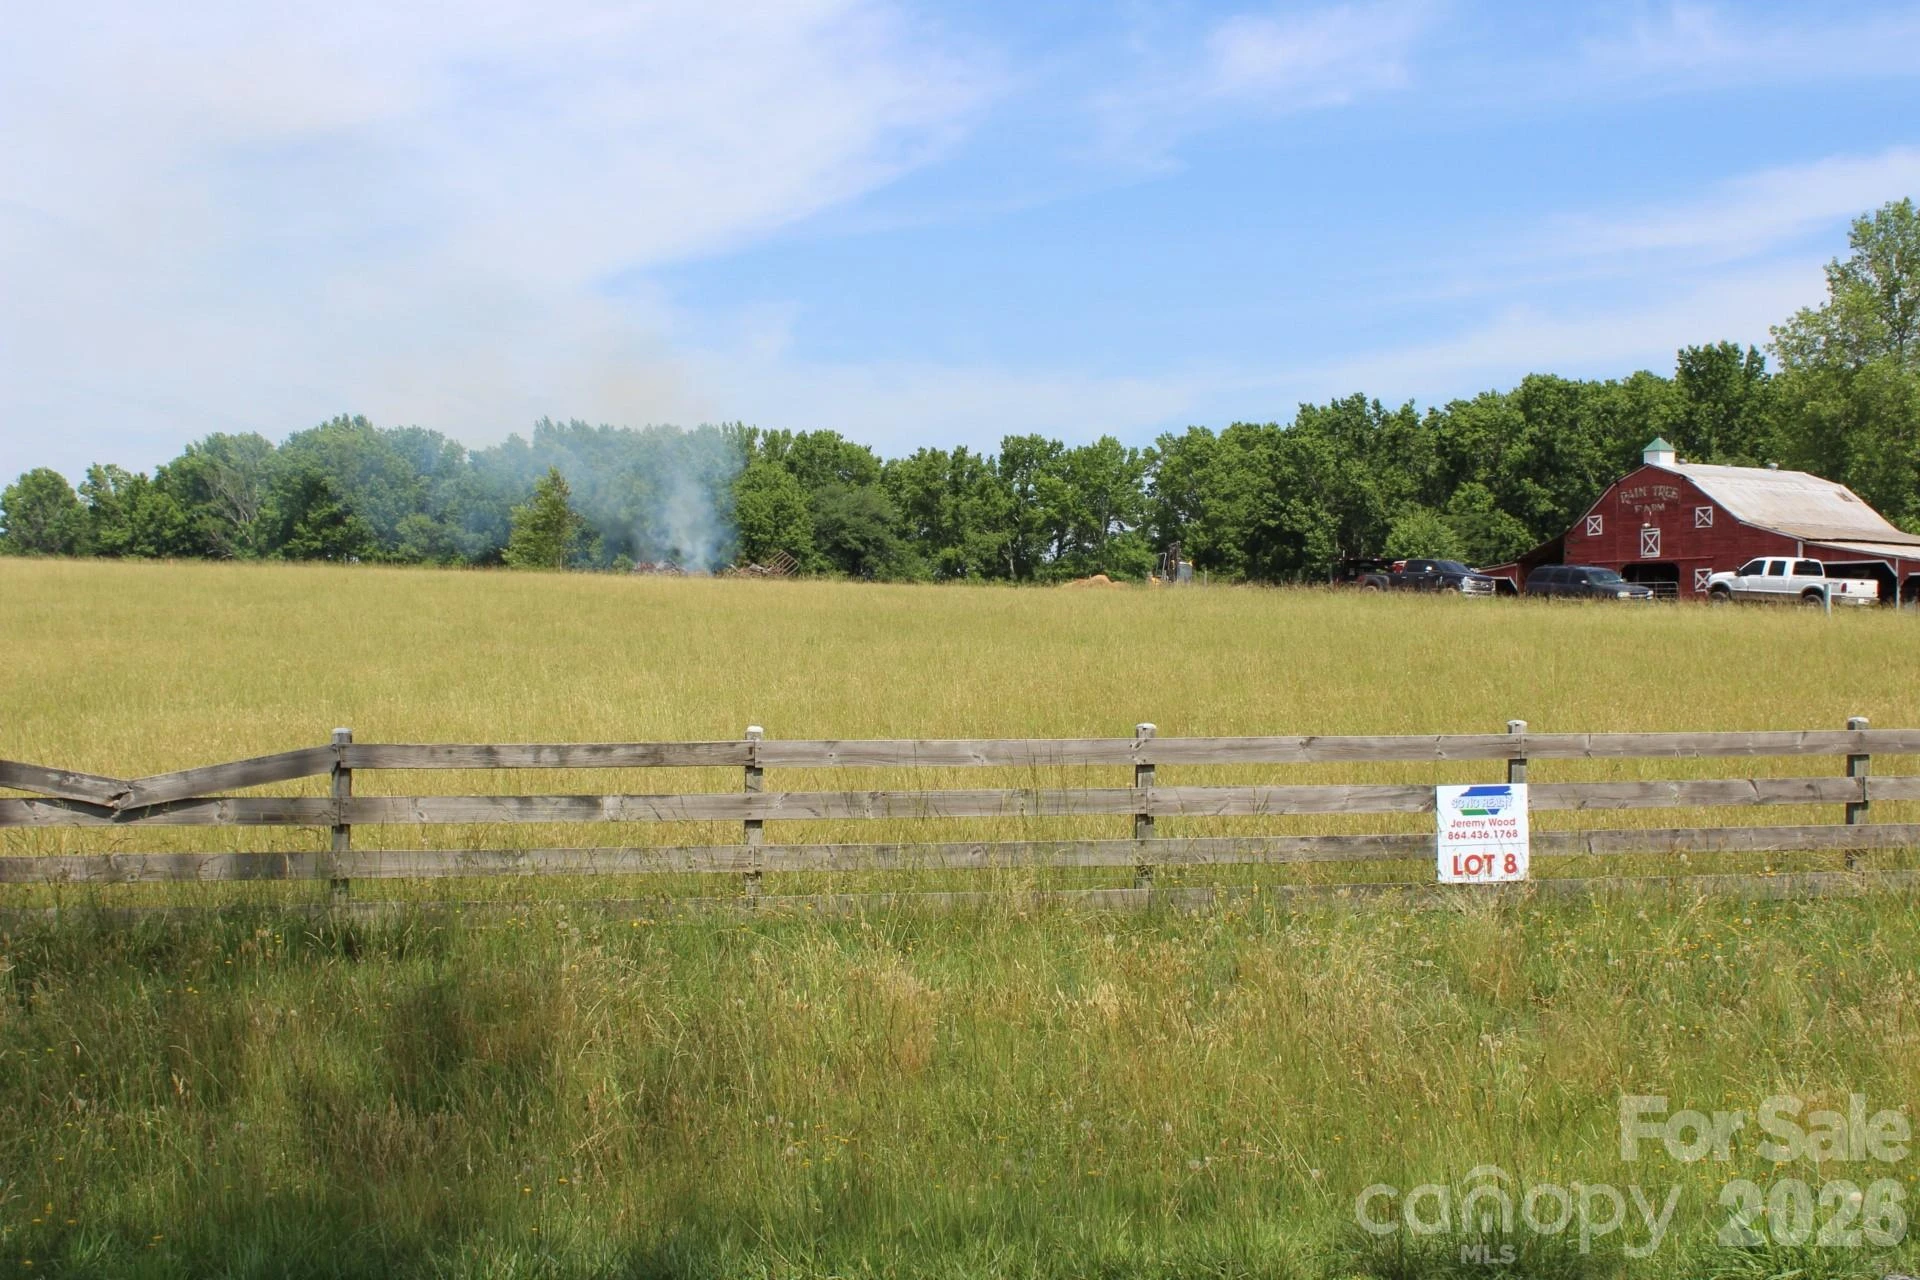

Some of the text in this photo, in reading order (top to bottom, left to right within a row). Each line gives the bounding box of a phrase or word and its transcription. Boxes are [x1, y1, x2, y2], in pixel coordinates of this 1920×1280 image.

[1450, 818, 1516, 829] Jeremy Wood
[1448, 829, 1518, 840] 864.436.1768
[1453, 853, 1518, 876] LOT 8
